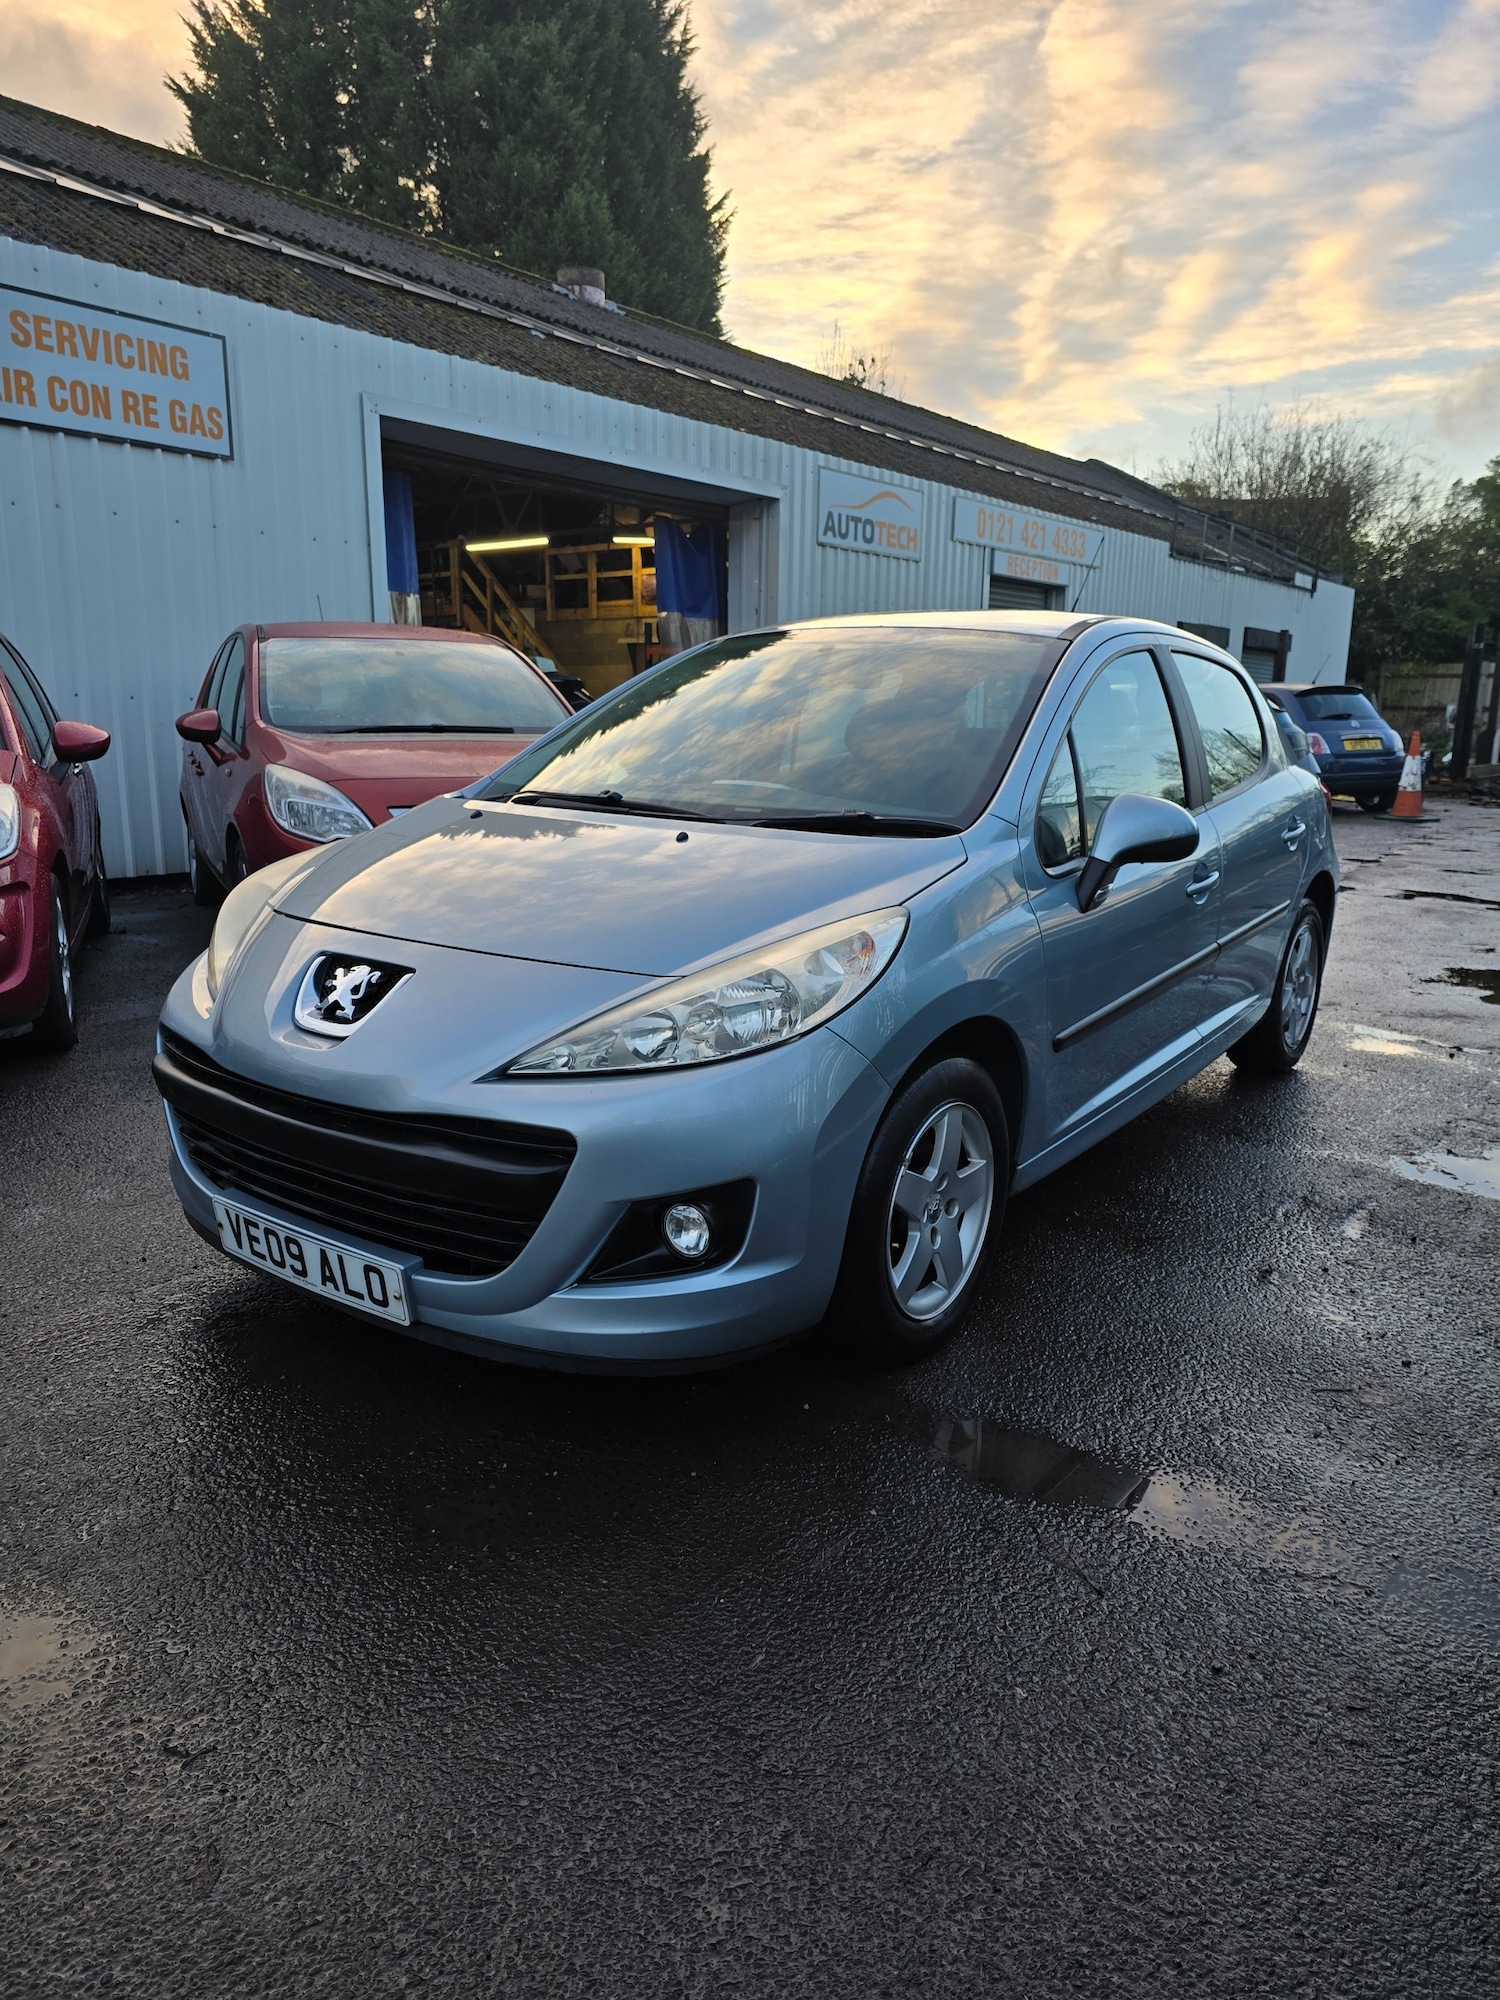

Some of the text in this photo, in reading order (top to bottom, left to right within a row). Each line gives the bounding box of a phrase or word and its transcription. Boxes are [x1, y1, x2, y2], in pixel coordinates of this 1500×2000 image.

[9, 309, 190, 381] SERVICING
[0, 366, 224, 441] IR CON RE GAS
[822, 510, 918, 552] AUTOTECH
[976, 507, 1086, 559] 0121 421 4333
[1007, 555, 1058, 582] RECEPTION
[224, 1208, 390, 1309] VE09 ALO
